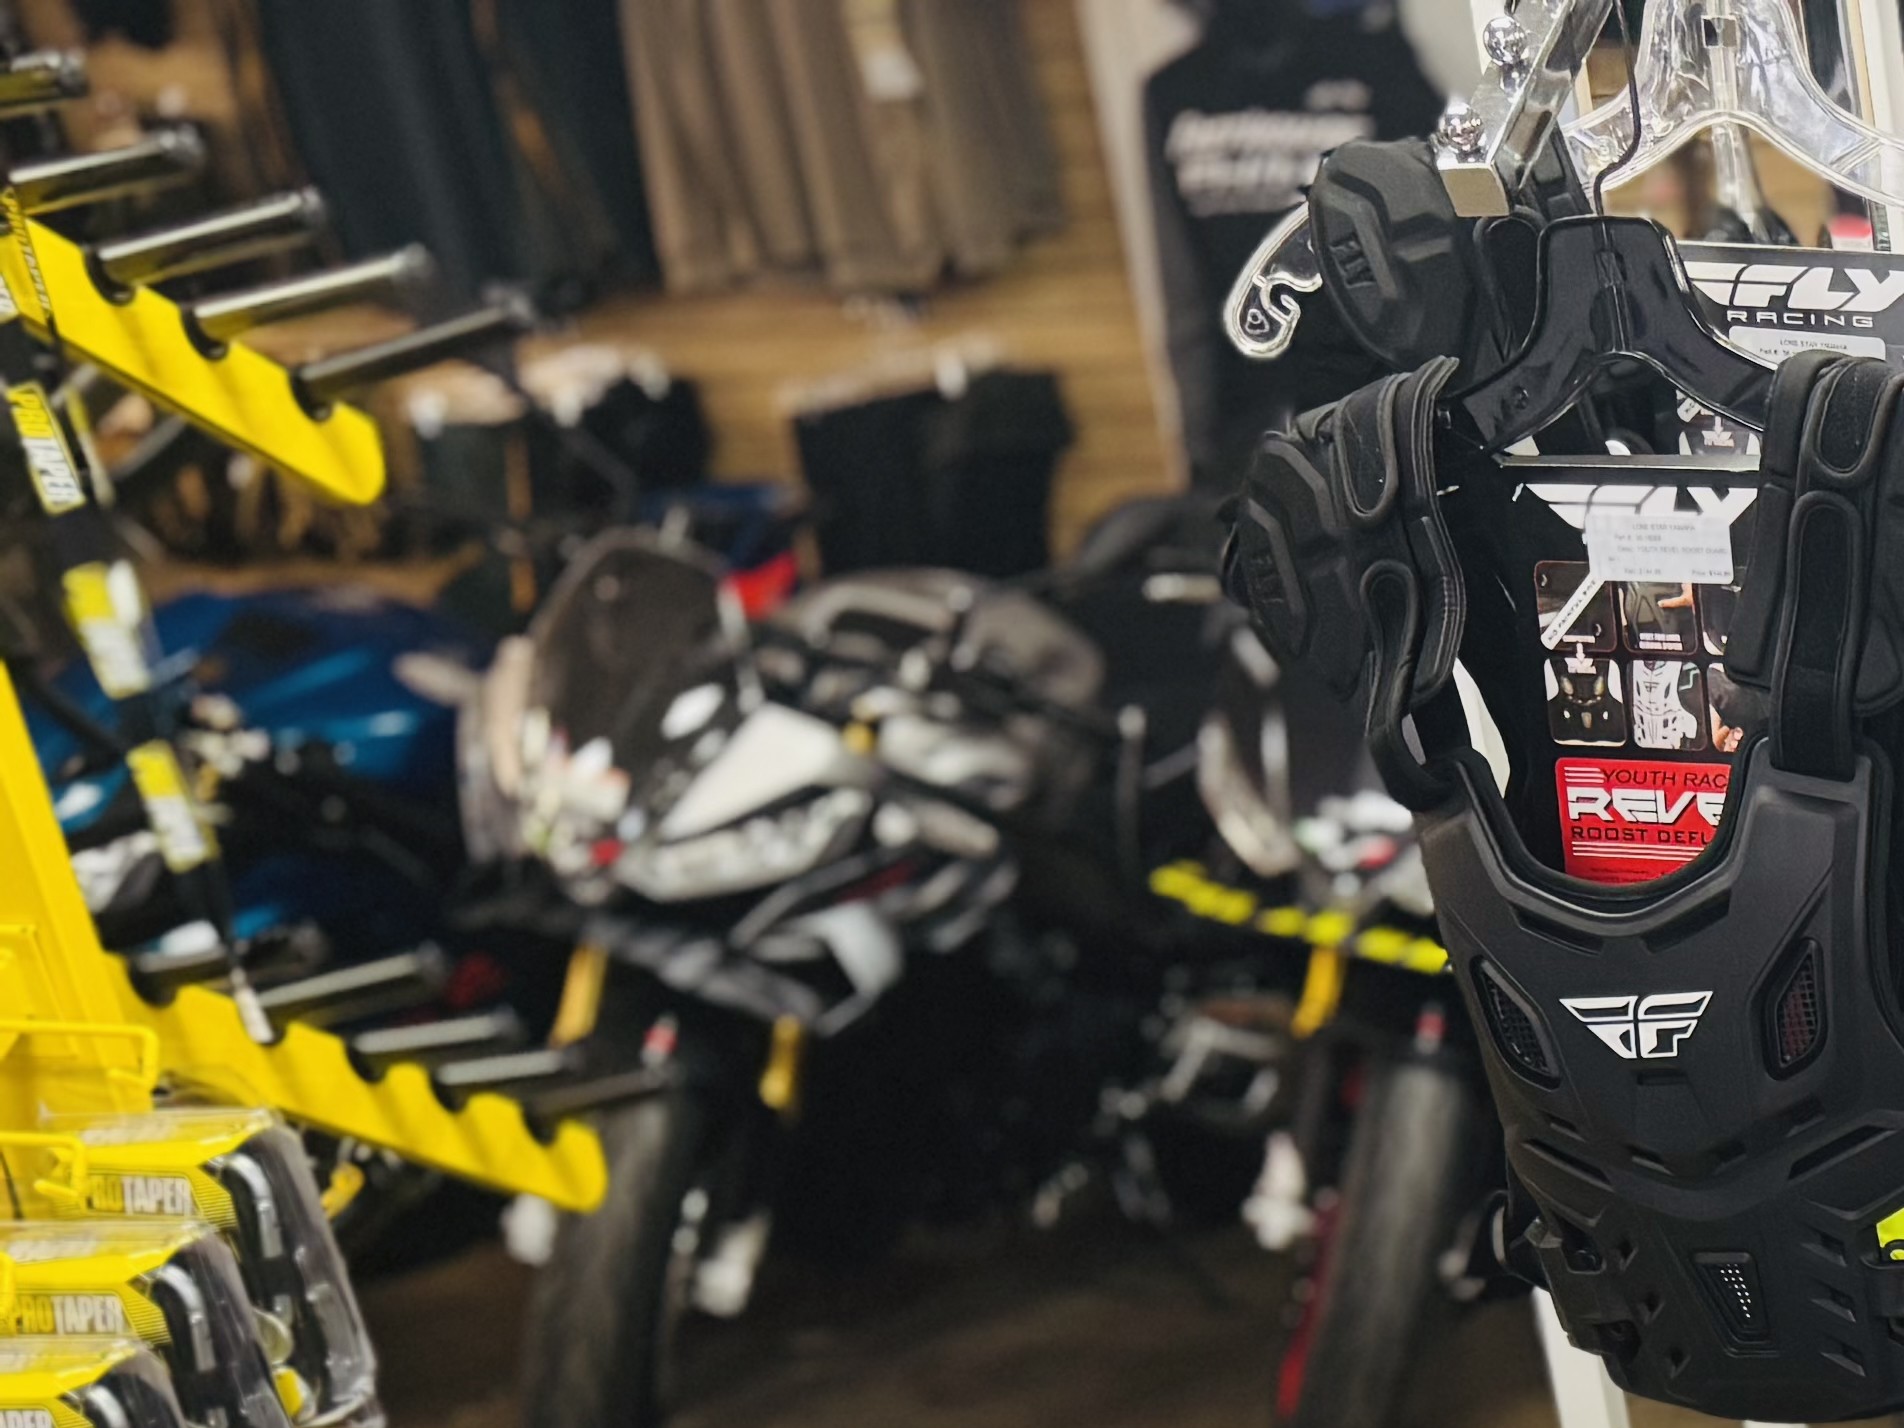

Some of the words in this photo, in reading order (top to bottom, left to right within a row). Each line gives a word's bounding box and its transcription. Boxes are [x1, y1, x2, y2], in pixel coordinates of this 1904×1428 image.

[1727, 310, 1873, 328] RACING
[1603, 769, 1676, 787] YOUTH
[1571, 826, 1648, 842] ROOST
